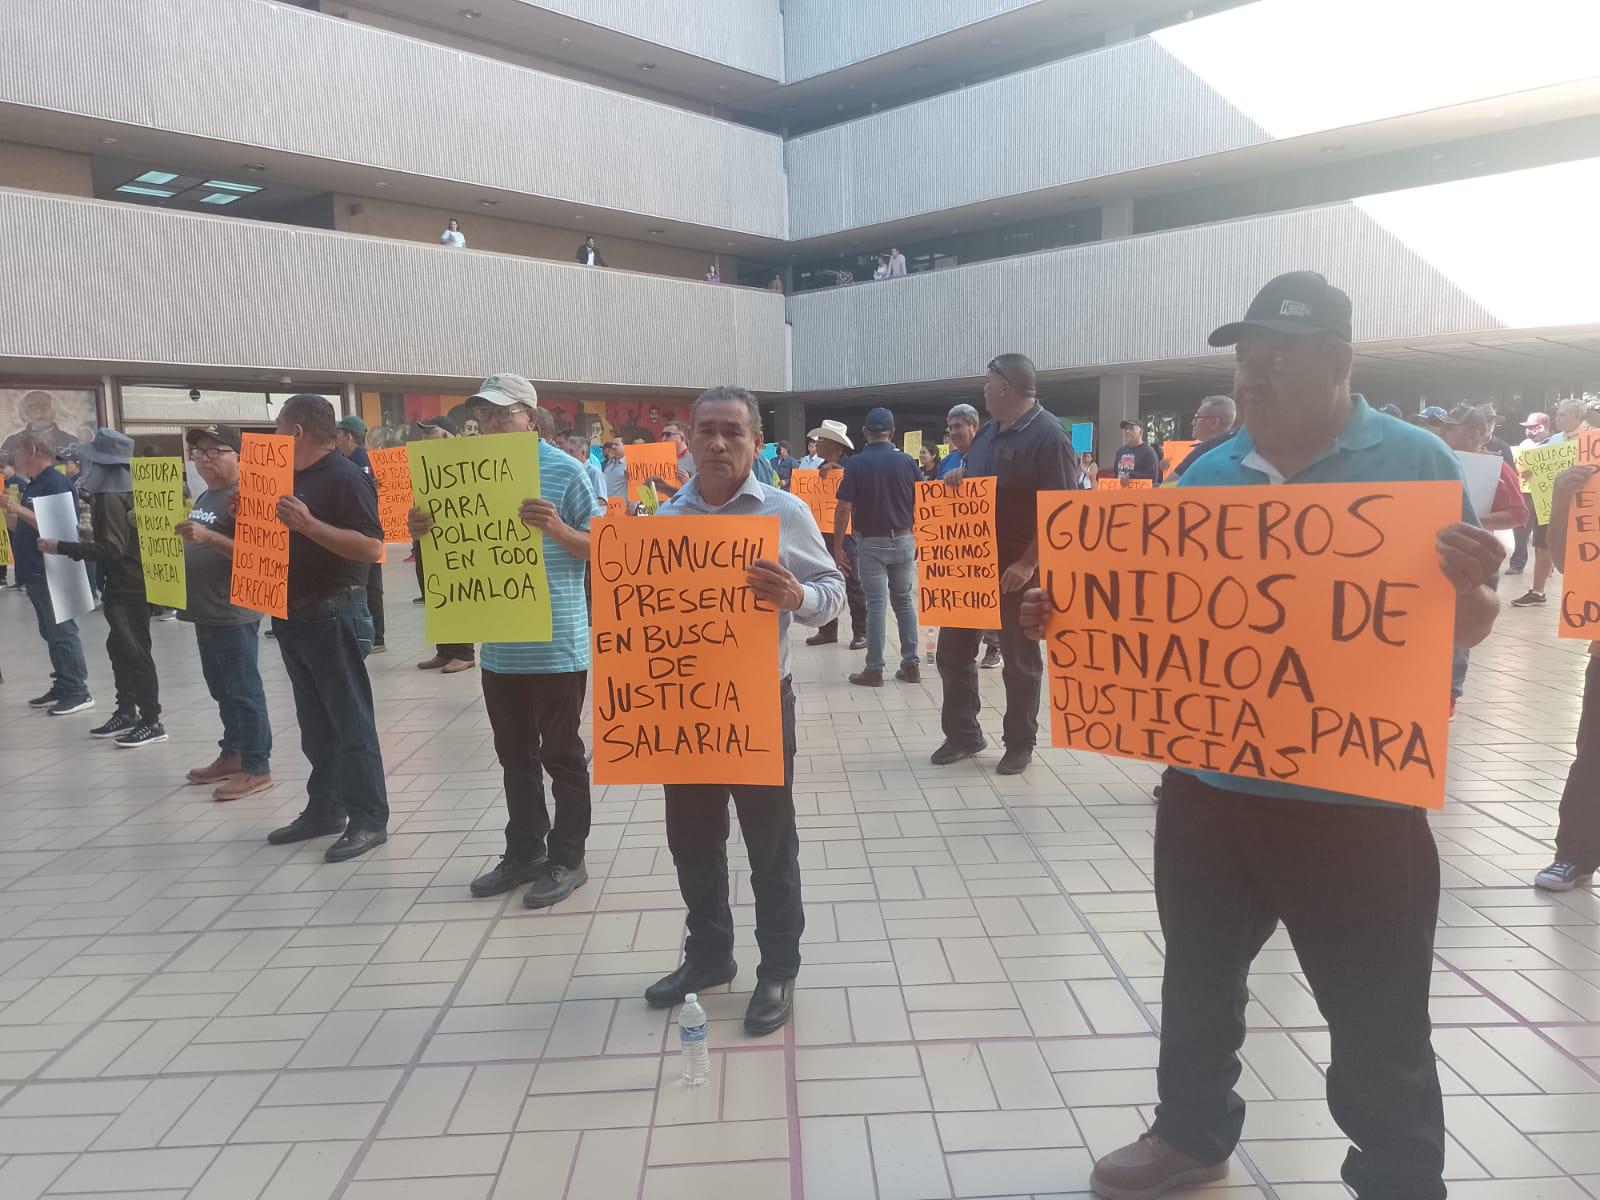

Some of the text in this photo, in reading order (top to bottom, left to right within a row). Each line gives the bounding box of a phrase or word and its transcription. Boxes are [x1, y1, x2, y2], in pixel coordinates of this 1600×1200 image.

[132, 462, 179, 483] NGOSTURA
[418, 455, 514, 495] JUSTICIA
[1532, 460, 1574, 476] PRESEN
[250, 472, 277, 496] TODO
[921, 479, 988, 502] POLICIAS
[135, 490, 176, 511] RESENTE
[428, 493, 490, 523] PARA
[919, 500, 990, 521] DE TODO
[145, 515, 171, 531] BUSCA
[237, 522, 287, 551] TENEMOS
[430, 517, 532, 551] POLICIAS
[919, 520, 991, 542] SINALOA
[1046, 494, 1395, 562] GUERREROS
[148, 536, 183, 558] JUSTICIA
[236, 550, 254, 569] LOS
[446, 546, 538, 570] EN TODO
[919, 541, 991, 562] EXIGIMOS
[925, 563, 996, 580] NUESTROS
[231, 574, 286, 609] DERECHOS
[427, 573, 537, 609] SINALOA
[613, 583, 775, 621] PRESENTE
[920, 586, 998, 613] DERECHOS
[1047, 569, 1421, 648] UNIDOS DE
[596, 620, 739, 655] EN BUSCA
[648, 655, 698, 679] DE
[1051, 628, 1315, 704] SINALOA
[599, 676, 741, 721] JUSTICIA
[1053, 675, 1435, 780] JUSTICIA PARA
[602, 722, 771, 763] SALARIAL
[1063, 712, 1307, 779] POLICIAS
